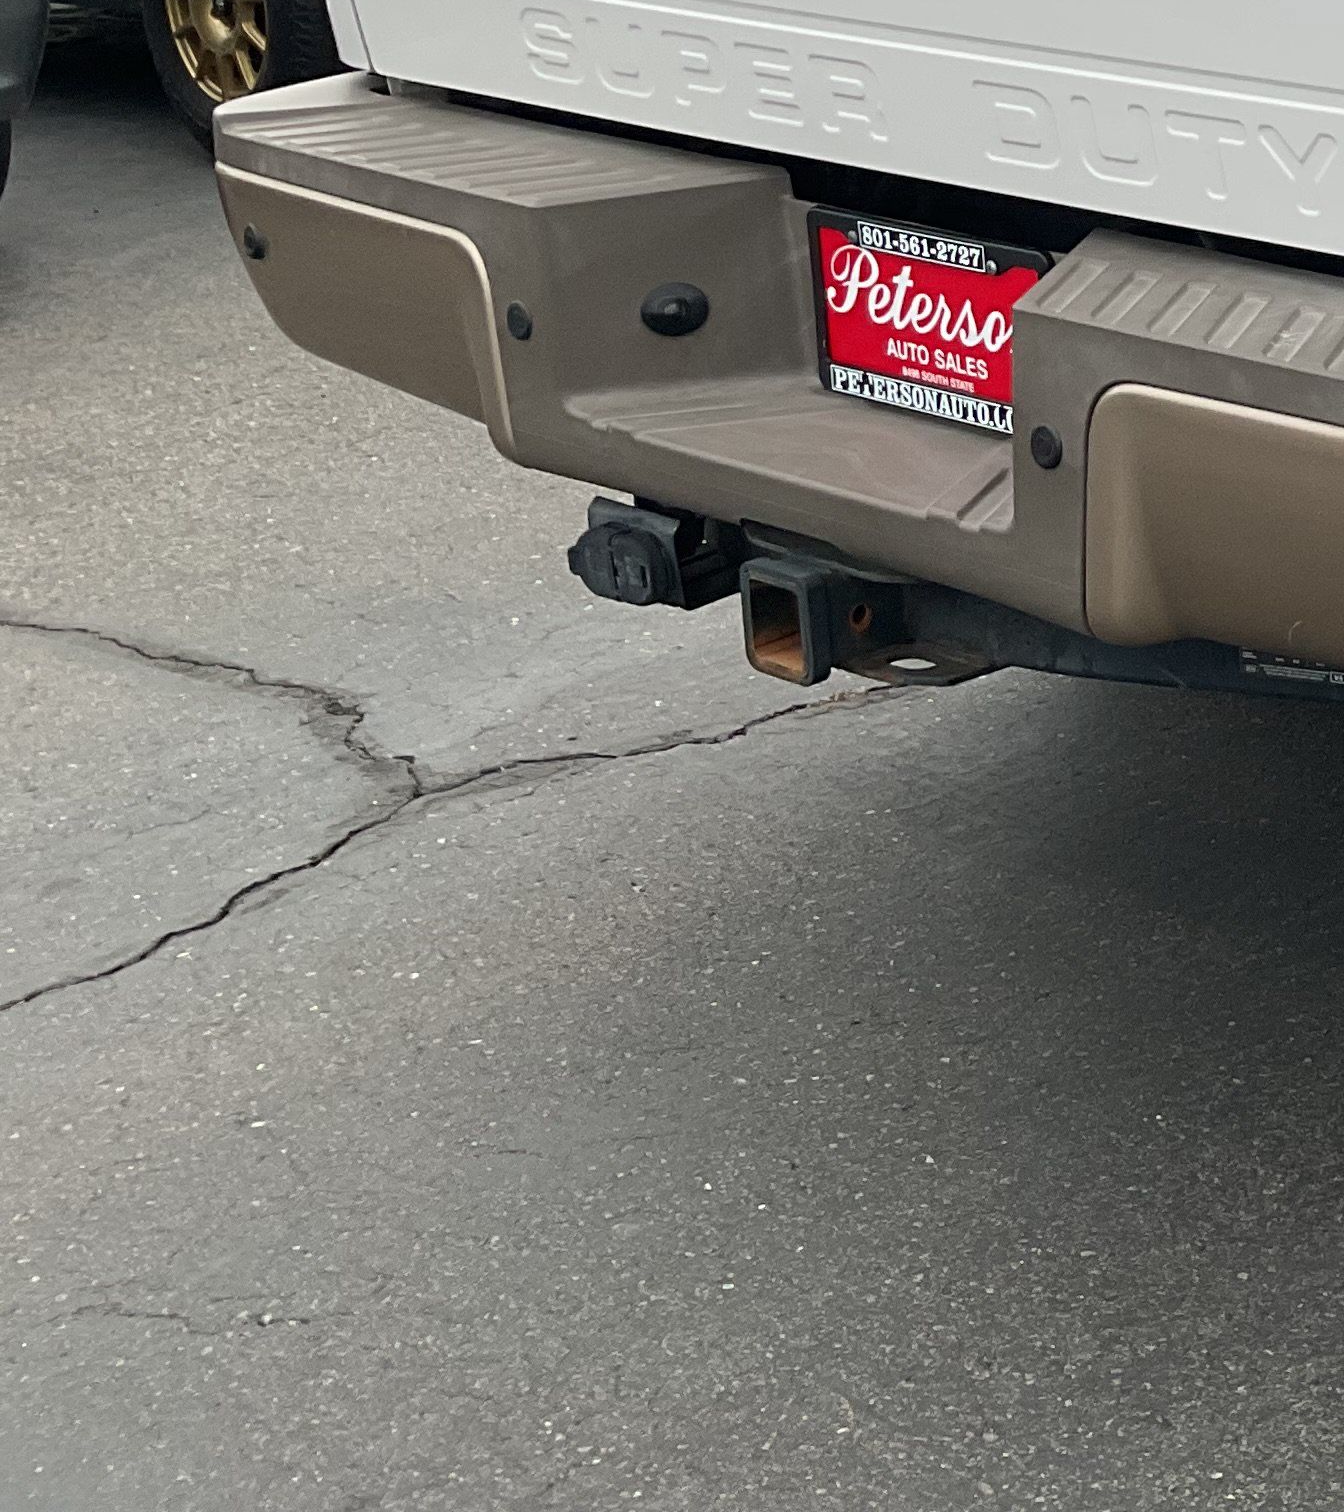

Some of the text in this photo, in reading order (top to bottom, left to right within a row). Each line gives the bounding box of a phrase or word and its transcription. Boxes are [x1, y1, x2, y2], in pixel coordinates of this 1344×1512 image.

[520, 7, 1338, 217] SUPER DUTY
[862, 225, 981, 268] 801-561-2727
[827, 245, 1012, 353] Peterso
[886, 337, 930, 366] AUTO
[934, 348, 989, 380] SALES
